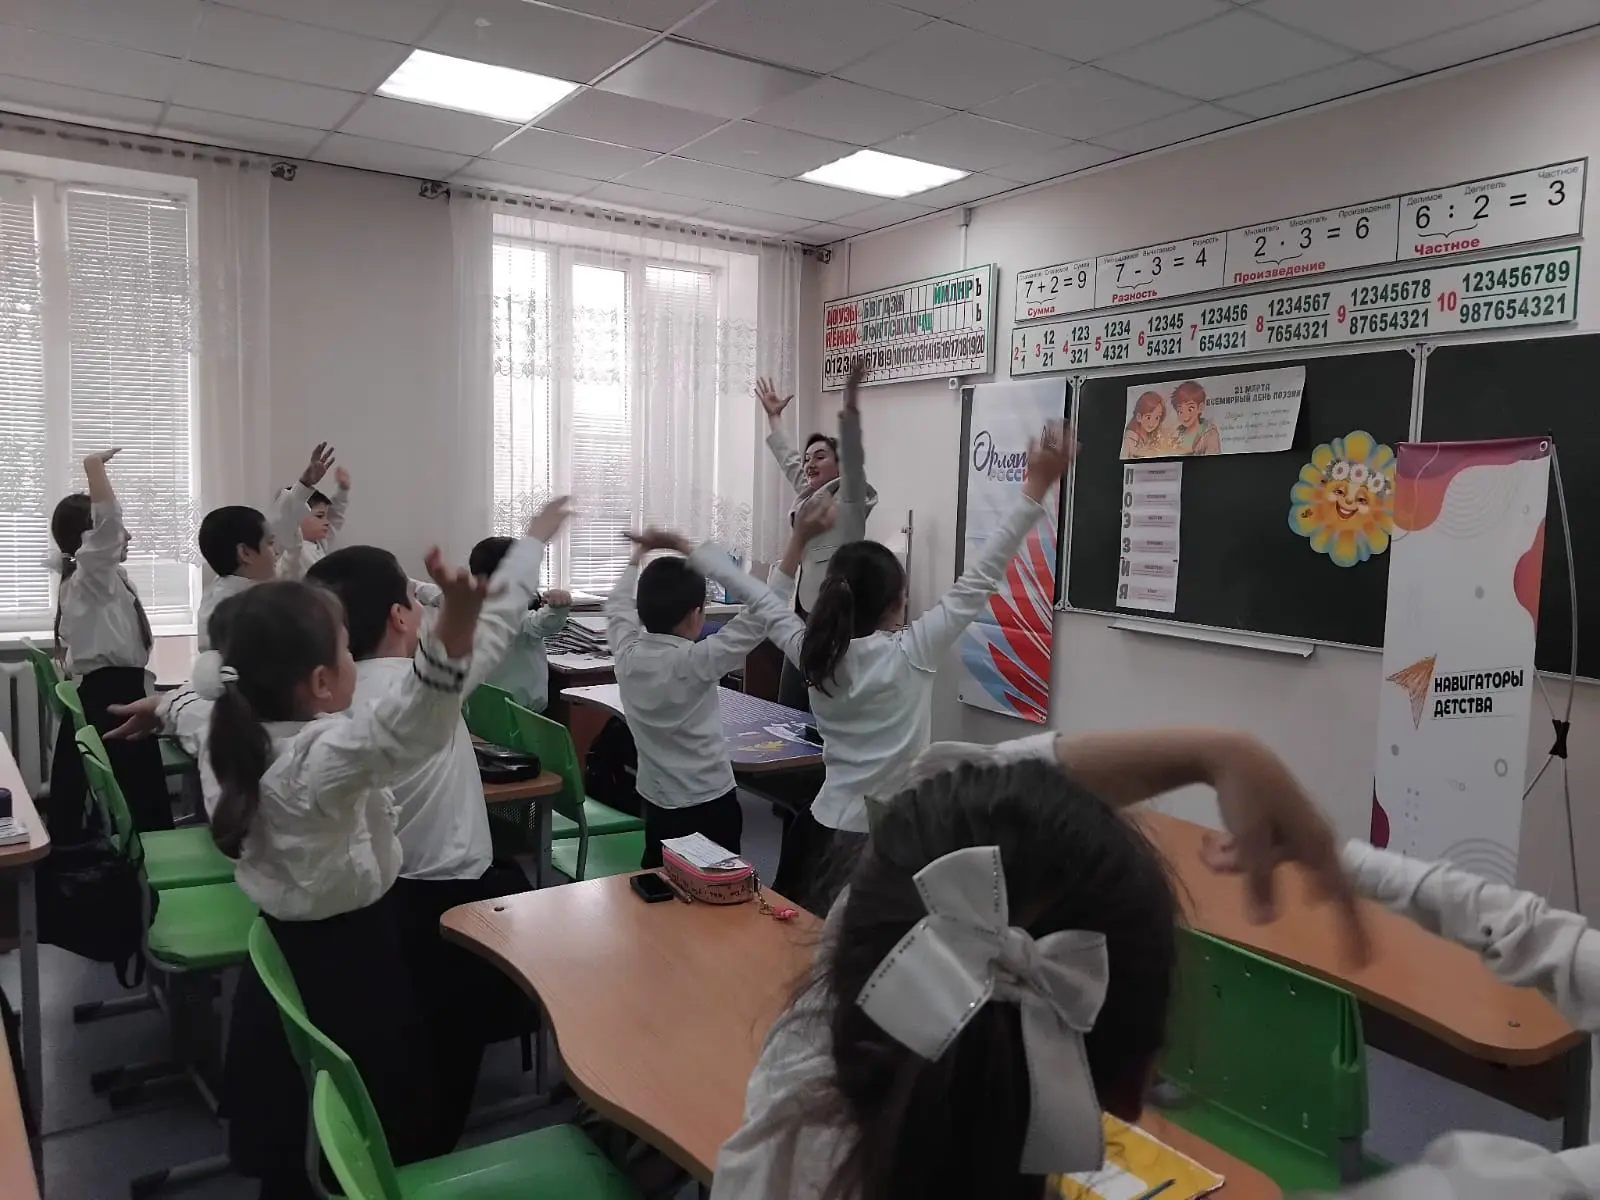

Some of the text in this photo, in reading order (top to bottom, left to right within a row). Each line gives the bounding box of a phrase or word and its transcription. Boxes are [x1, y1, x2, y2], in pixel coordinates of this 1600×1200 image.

[1538, 166, 1579, 179] Частное
[1415, 205, 1431, 229] 6
[1473, 195, 1490, 220] 2
[1509, 193, 1527, 207] =
[1548, 180, 1565, 206] 3
[1254, 236, 1266, 257] 2
[1300, 228, 1312, 249] 3
[1327, 227, 1341, 239] =
[1355, 216, 1369, 239] 6
[1414, 238, 1481, 256] Частное
[1115, 264, 1125, 283] 7
[1152, 256, 1162, 276] 3
[1173, 256, 1185, 267] =
[1196, 248, 1207, 267] 4
[1233, 261, 1326, 284] Произведение
[1025, 281, 1034, 298] 7
[1037, 282, 1046, 293] +
[1050, 276, 1059, 294] 2
[1063, 277, 1073, 288] =
[1077, 270, 1087, 288] 9
[1462, 260, 1570, 293] 123456789
[1112, 289, 1158, 304] Разность
[1351, 278, 1431, 307] 12345678
[1437, 291, 1457, 312] 10
[1027, 305, 1056, 317] Сумма
[1268, 292, 1331, 317] 1234567
[1460, 293, 1566, 324] 987654321
[1147, 313, 1184, 333] 12345
[1201, 303, 1248, 326] 123456
[1337, 305, 1347, 324] 9
[1349, 307, 1429, 336] 87654321
[1071, 325, 1090, 341] 123
[1104, 320, 1131, 338] 1234
[1190, 324, 1198, 341] 7
[1255, 315, 1264, 333] 8
[1267, 319, 1328, 343] 7654321
[1021, 333, 1026, 348] 1
[1043, 330, 1055, 345] 12
[1063, 339, 1069, 354] 4
[1095, 336, 1102, 352] 5
[1137, 331, 1145, 347] 6
[1146, 336, 1182, 357] 54321
[1199, 330, 1247, 352] 654321
[1013, 347, 1019, 360] 2
[1035, 343, 1041, 357] 3
[1042, 351, 1054, 367] 21
[1070, 348, 1089, 364] 321
[1102, 343, 1130, 361] 4321
[1021, 355, 1026, 369] 1
[1206, 393, 1251, 406] ВСЕМИРНЫЙ
[1252, 393, 1272, 402] ДЕНЬ
[1434, 669, 1524, 693] НАВИГАТОРЫ
[1433, 697, 1493, 718] ДЕТСТВА
